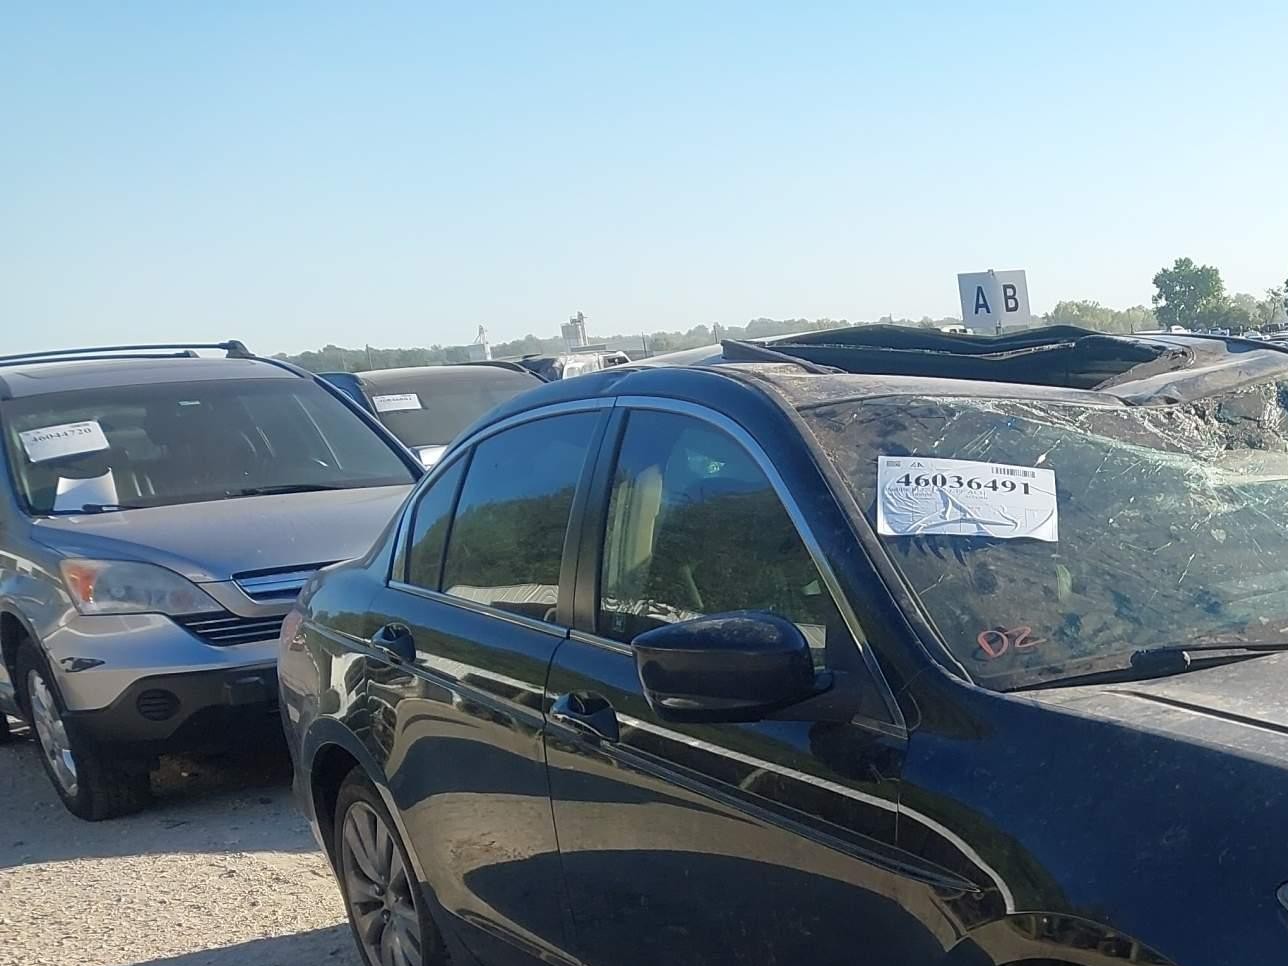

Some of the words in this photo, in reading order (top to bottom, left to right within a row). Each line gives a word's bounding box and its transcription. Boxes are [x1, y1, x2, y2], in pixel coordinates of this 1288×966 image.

[974, 286, 991, 314] A
[1003, 284, 1018, 312] B
[896, 473, 1030, 495] 46036491
